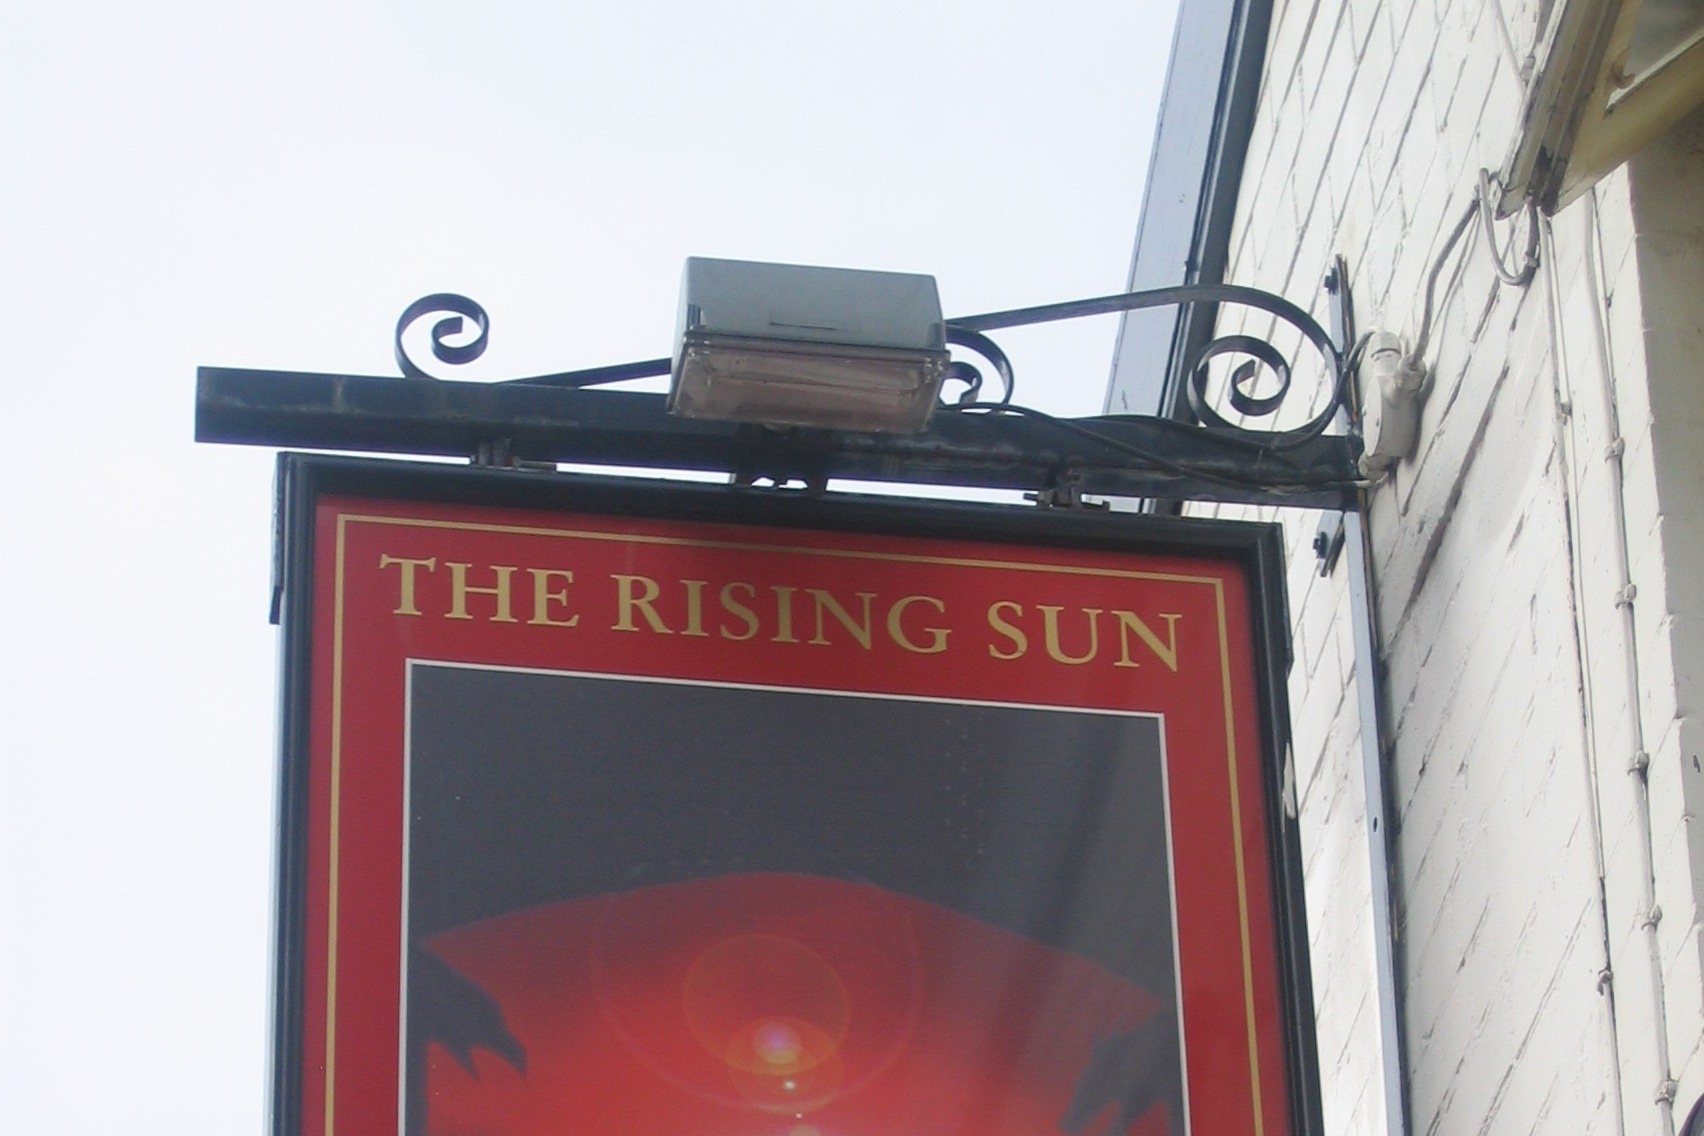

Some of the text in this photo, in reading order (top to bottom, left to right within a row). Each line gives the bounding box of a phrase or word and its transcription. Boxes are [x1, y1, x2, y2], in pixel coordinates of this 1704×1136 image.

[378, 553, 1183, 673] THE RISING SUN
